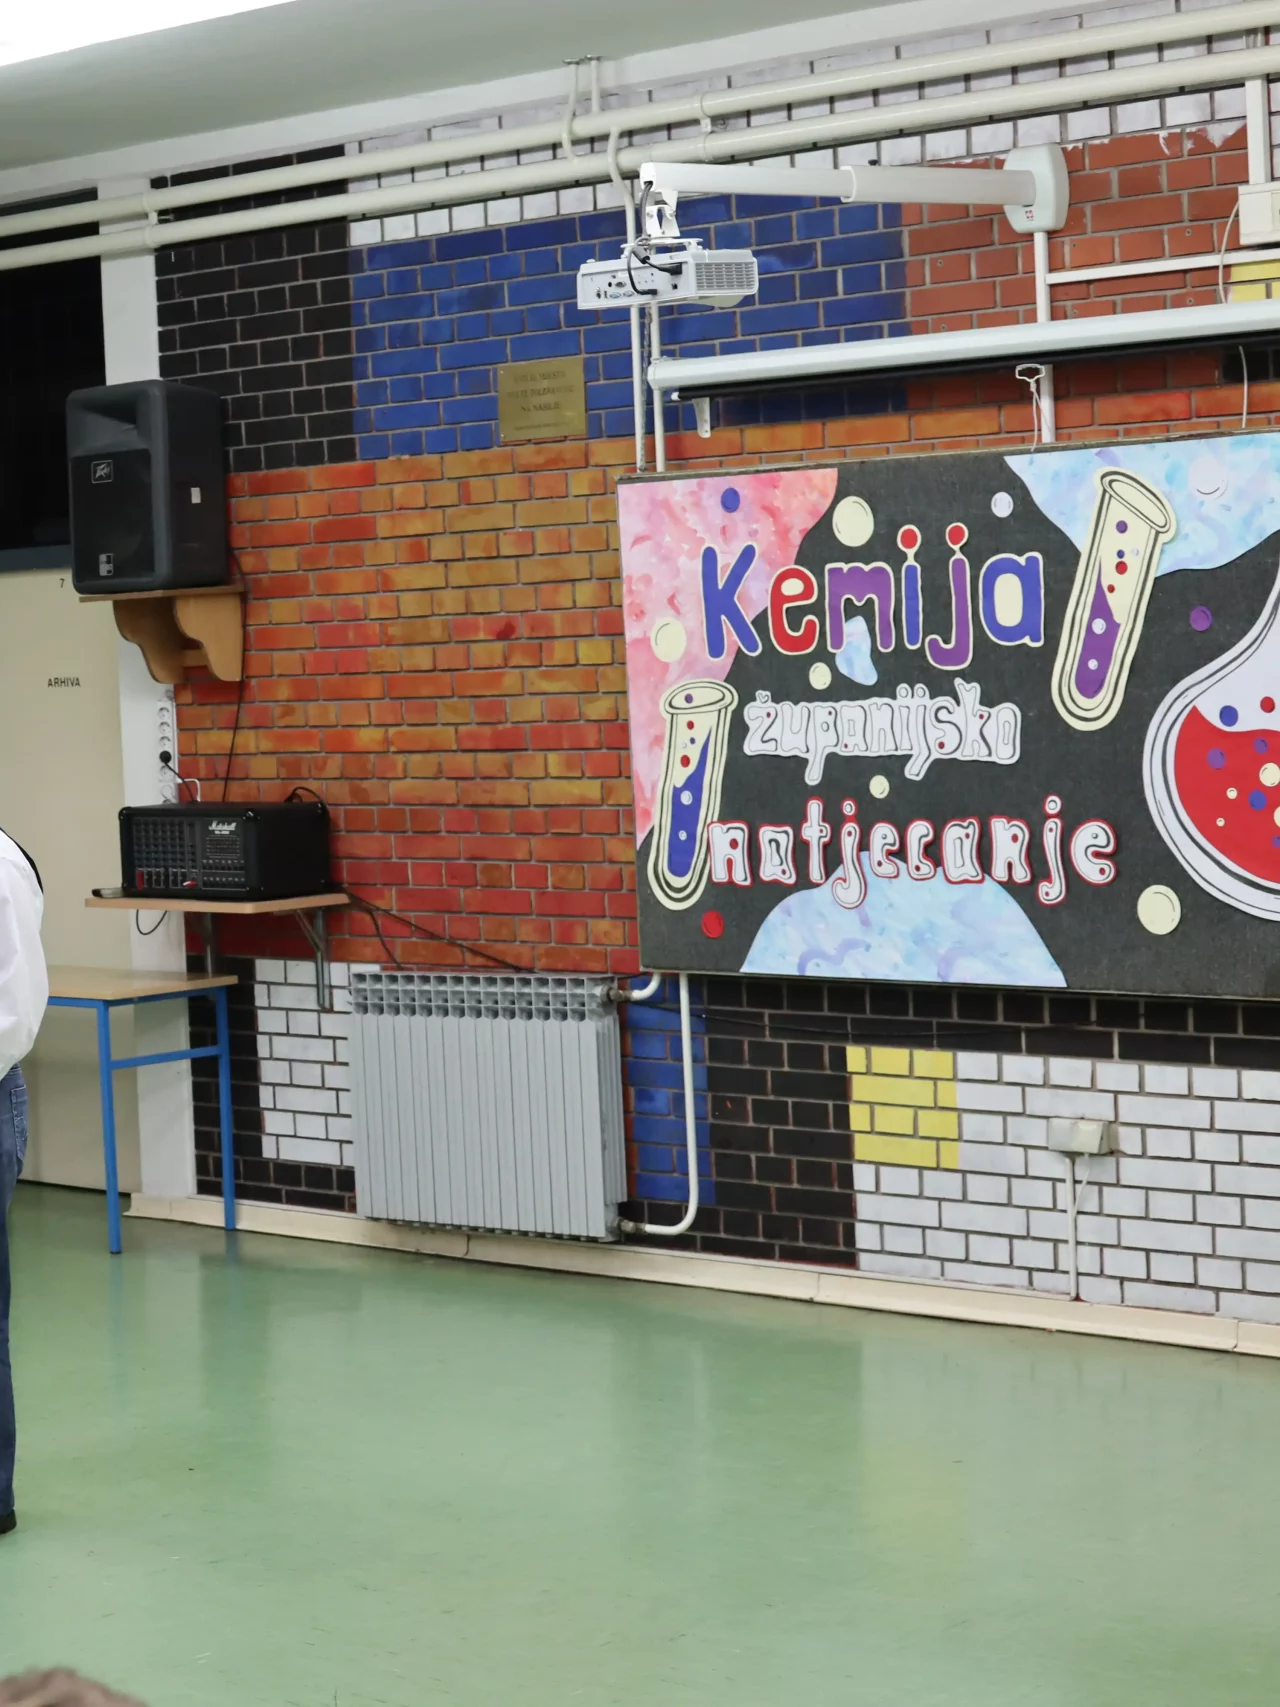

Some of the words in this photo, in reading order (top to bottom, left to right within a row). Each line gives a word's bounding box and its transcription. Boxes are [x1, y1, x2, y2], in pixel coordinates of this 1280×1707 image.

[59, 578, 65, 588] 7
[701, 523, 1044, 671] Kemija
[47, 677, 81, 688] ARHIVA
[708, 795, 1117, 909] natjecanje
